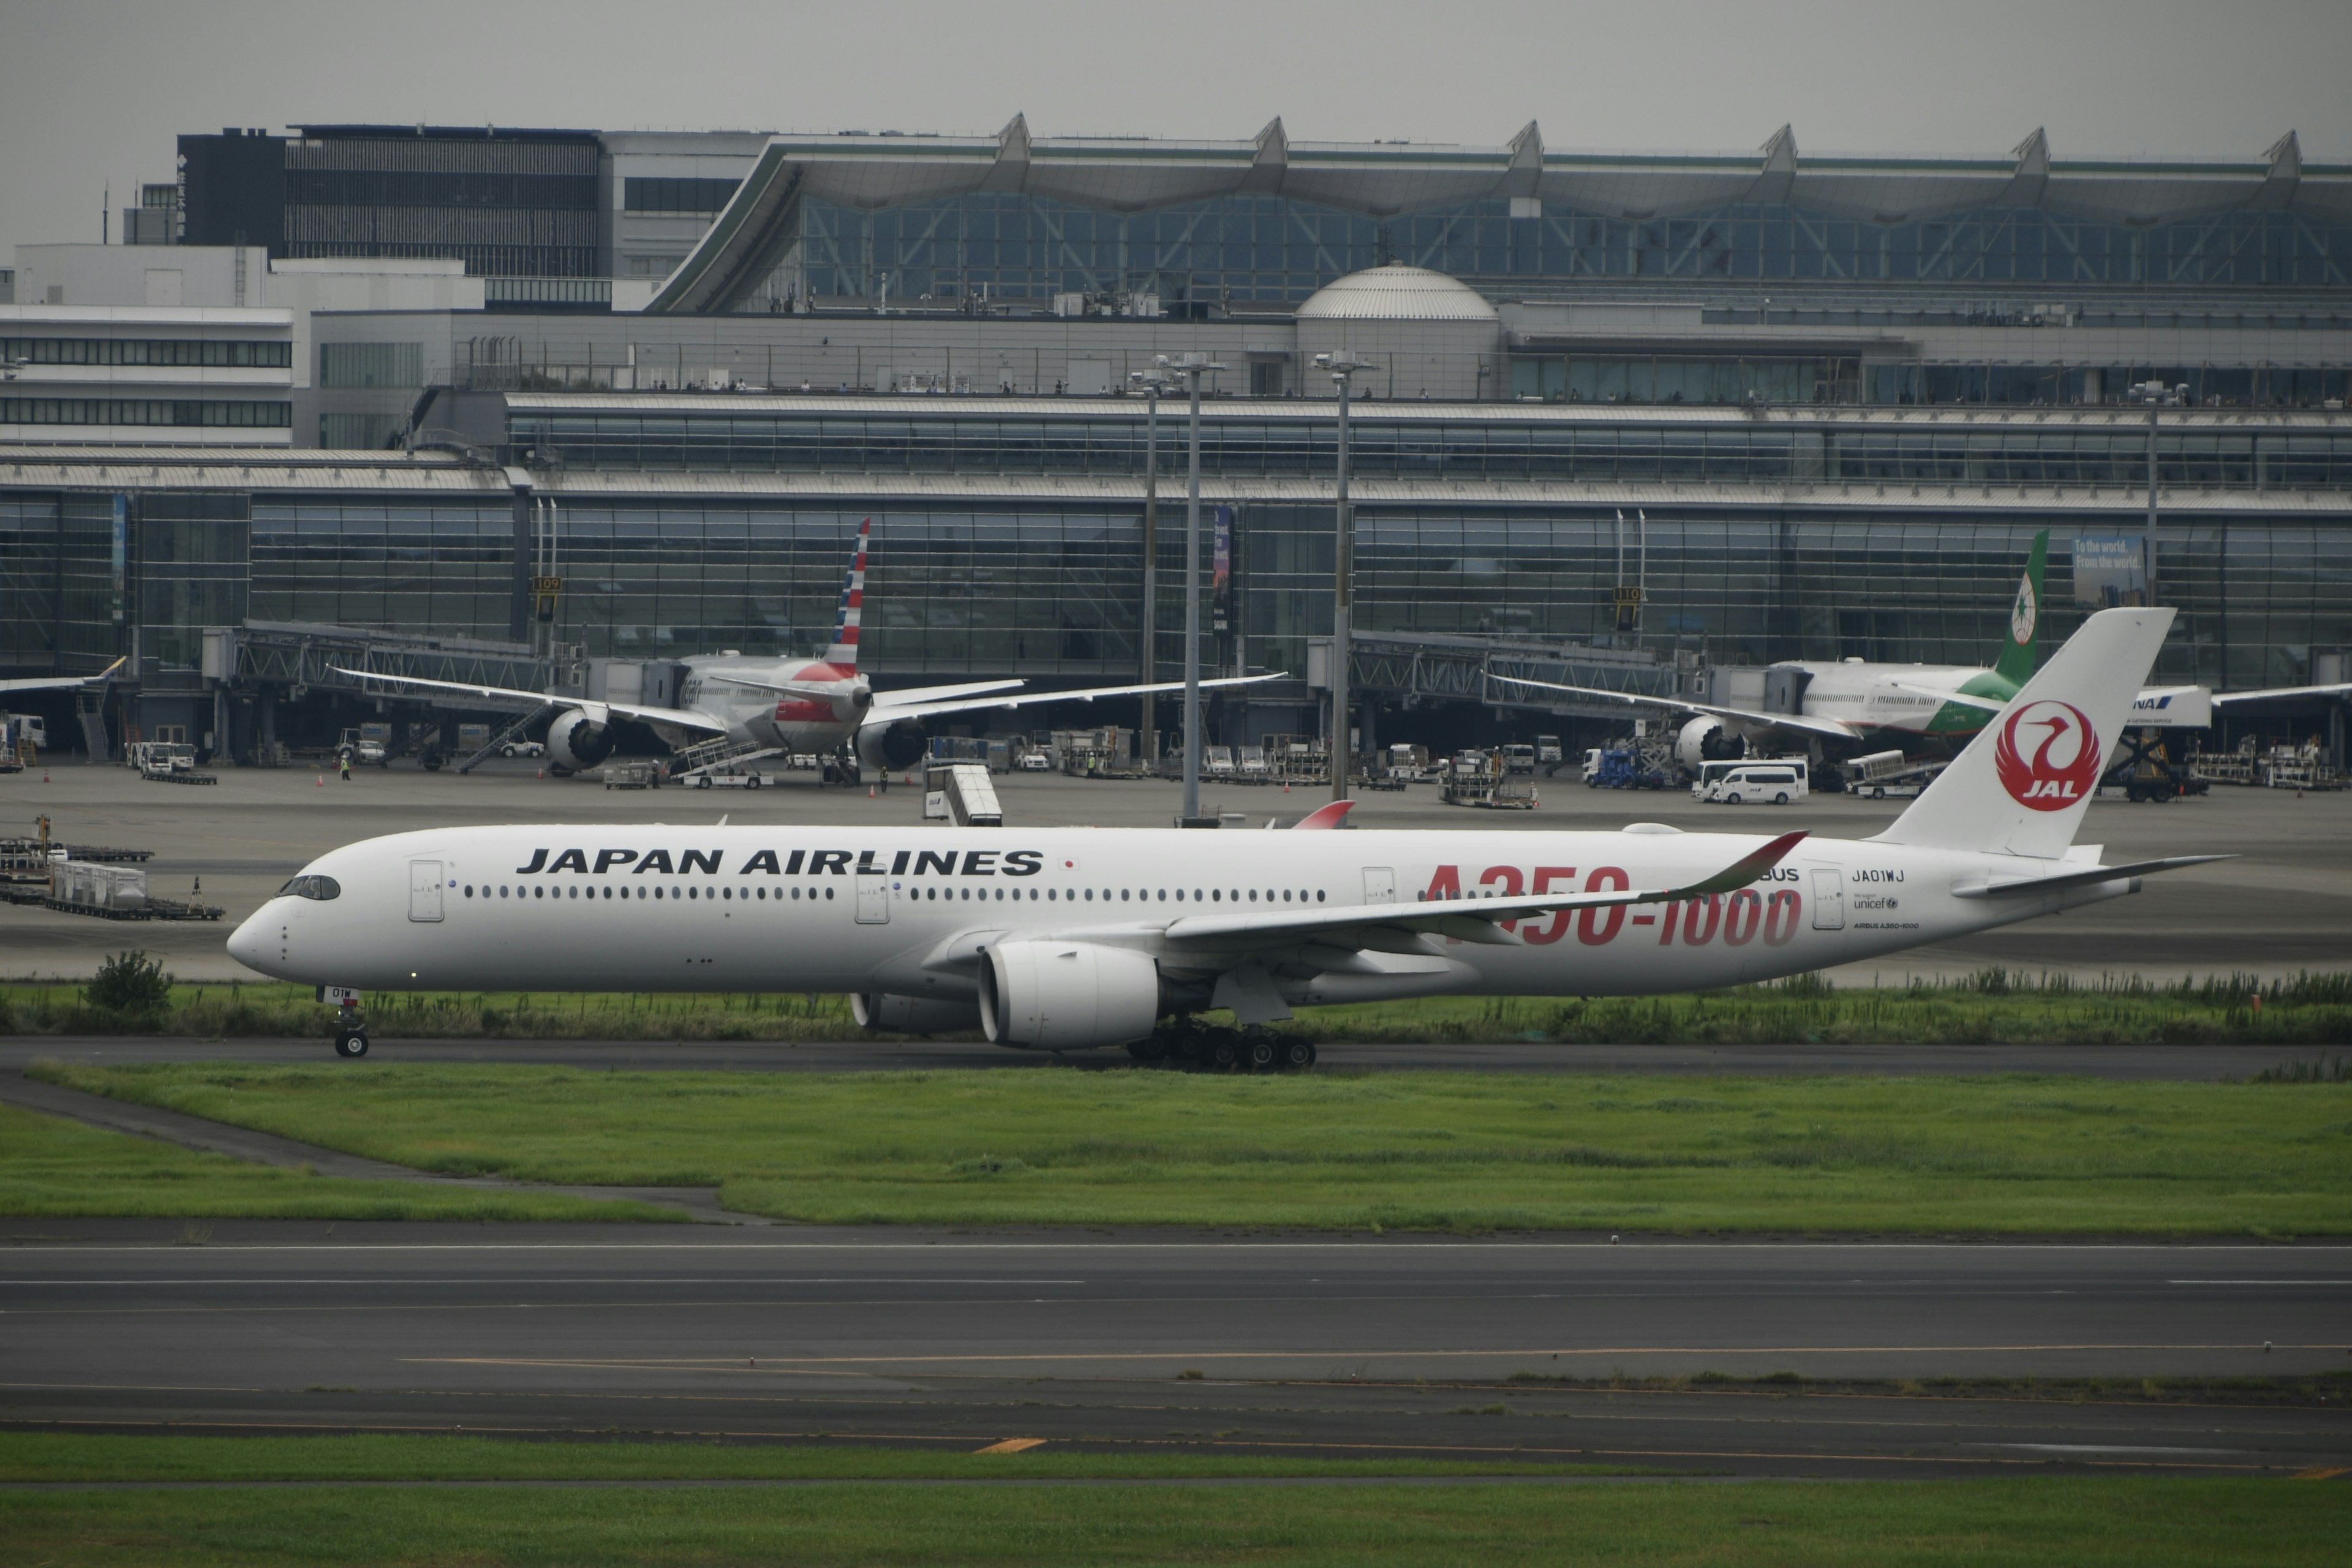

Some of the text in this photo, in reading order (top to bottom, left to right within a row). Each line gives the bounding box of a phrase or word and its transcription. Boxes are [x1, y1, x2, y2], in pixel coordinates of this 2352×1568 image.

[177, 172, 186, 236] 住友不動産
[2075, 539, 2128, 552] To the world.
[2076, 555, 2141, 568] From the world.
[539, 578, 559, 589] 109
[1619, 589, 1639, 599] 110
[681, 671, 703, 704] ican
[2133, 698, 2155, 709] NA
[2022, 779, 2078, 797] JAL
[516, 848, 1045, 876] JAPAN AIRLINES
[1760, 868, 1800, 882] BUS
[1852, 870, 1904, 882] JA01WJ
[1854, 898, 1885, 909] unicef
[333, 988, 351, 998] 01W
